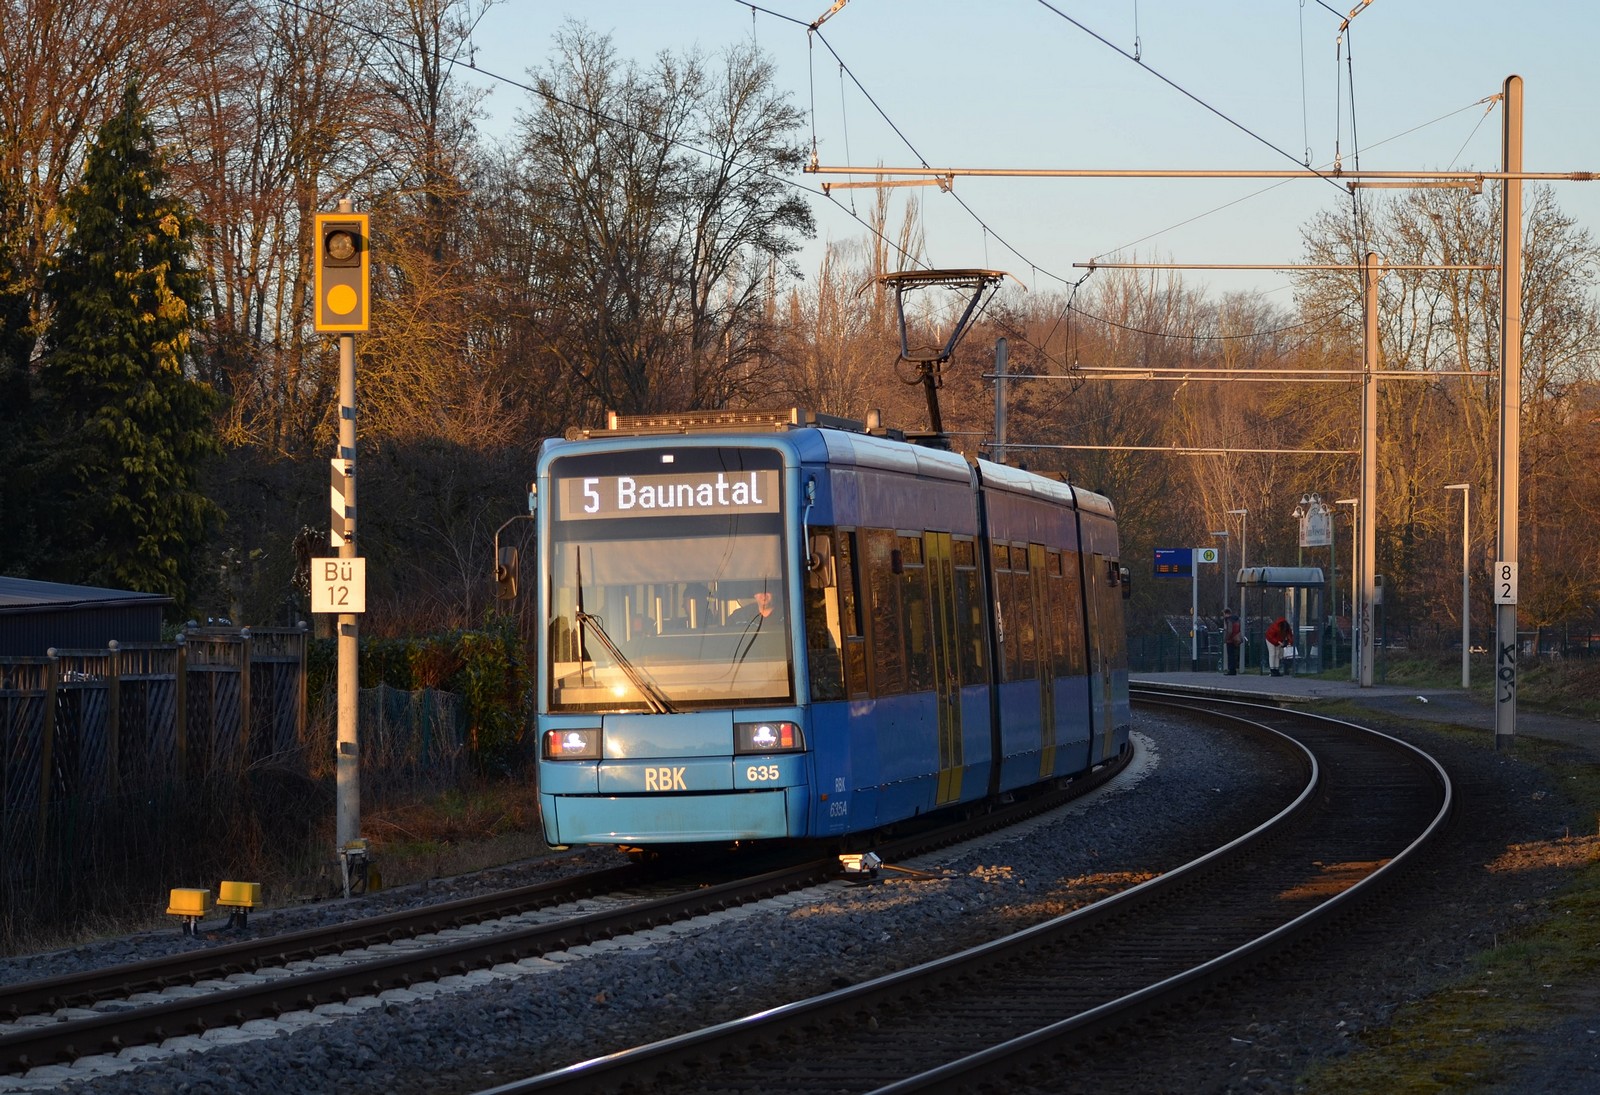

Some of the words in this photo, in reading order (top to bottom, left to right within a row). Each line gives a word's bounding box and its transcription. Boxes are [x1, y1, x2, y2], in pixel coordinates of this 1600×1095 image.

[583, 478, 600, 513] 5
[617, 471, 763, 510] Baunatal
[325, 561, 352, 581] Bü
[1501, 565, 1511, 580] 8
[328, 586, 349, 605] 12
[1501, 583, 1511, 598] 2
[645, 767, 687, 791] RBK
[746, 765, 780, 781] 635
[835, 776, 846, 792] RBK
